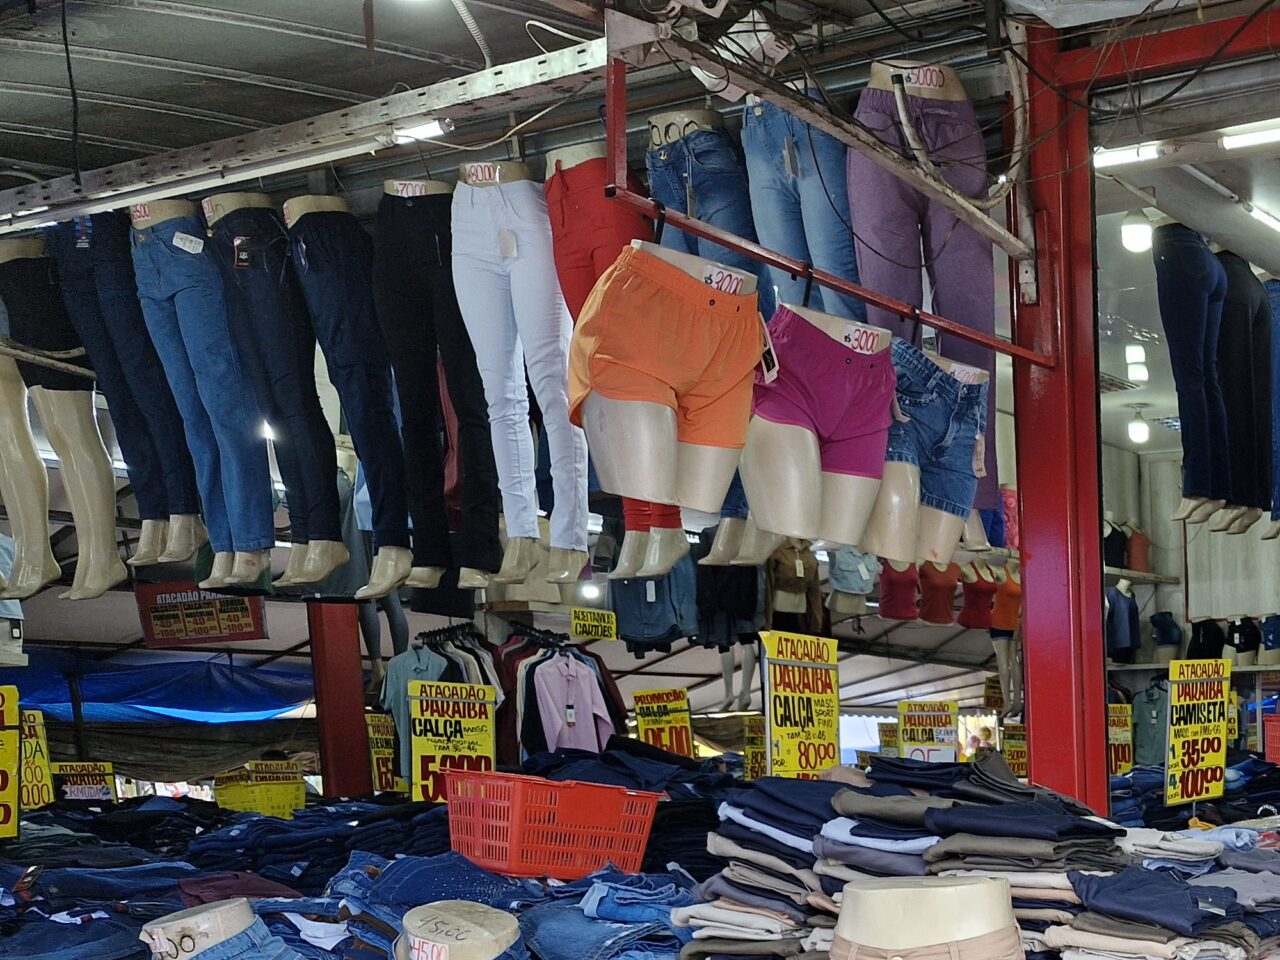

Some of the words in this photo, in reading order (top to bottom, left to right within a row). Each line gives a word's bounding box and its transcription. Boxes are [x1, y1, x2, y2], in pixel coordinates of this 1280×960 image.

[156, 590, 199, 604] ATACADÃO
[776, 636, 830, 663] ATACADÃO
[1178, 660, 1225, 679] ATACADÃO
[419, 684, 486, 700] ATACADÃO
[773, 694, 815, 732] CALÇA
[1171, 701, 1226, 727] CAMISETA
[412, 718, 464, 741] CALÇA
[58, 764, 106, 773] ATACADÃO
[64, 774, 109, 786] ARAIBA
